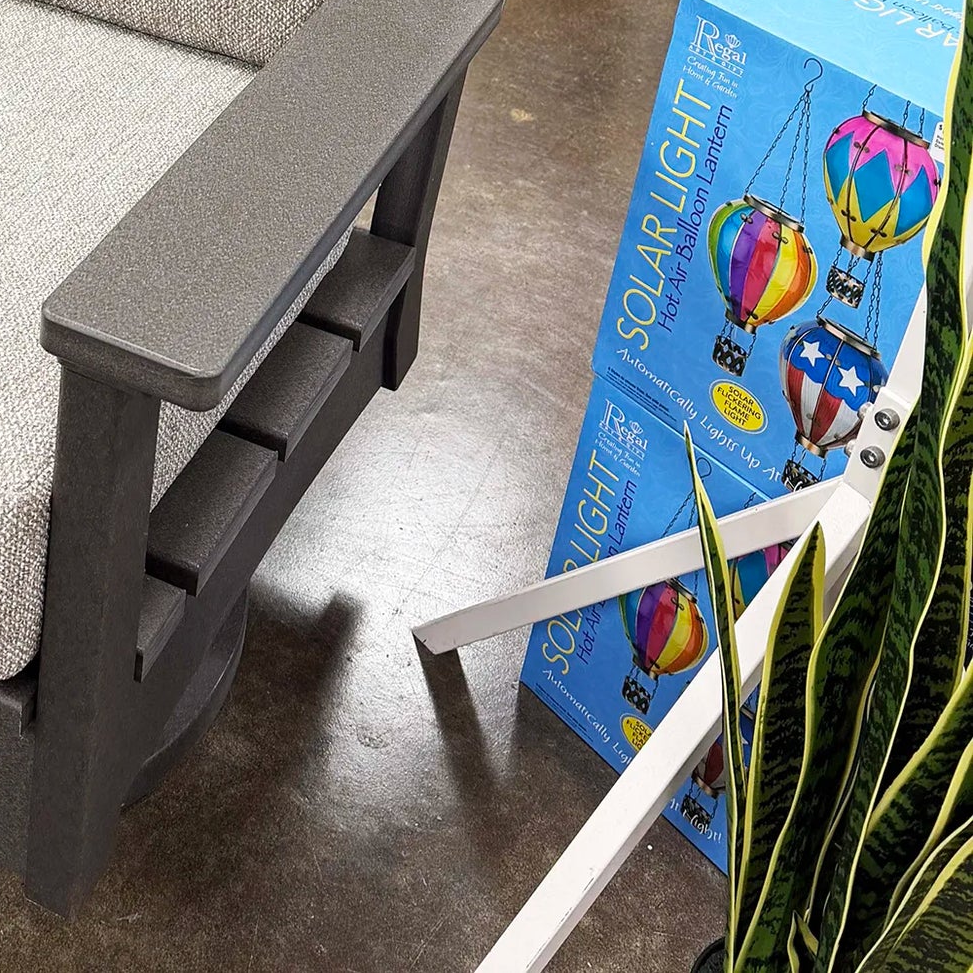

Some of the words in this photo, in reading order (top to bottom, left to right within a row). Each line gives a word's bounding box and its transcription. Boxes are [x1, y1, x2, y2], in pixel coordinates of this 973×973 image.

[690, 15, 747, 65] Regal
[683, 65, 703, 81] Home
[712, 81, 737, 99] Garden
[687, 56, 716, 80] Creating
[718, 71, 730, 84] Fun
[696, 104, 733, 185] Lantern
[616, 214, 677, 351] SOLAR
[649, 78, 711, 213] LIGHT
[675, 187, 708, 263] Balloon
[667, 261, 689, 295] Air
[658, 292, 680, 333] Hot
[717, 387, 761, 420] FLICKERING
[723, 408, 747, 426] LIGHT
[724, 399, 749, 421] FLAME
[728, 386, 754, 407] SOLAR
[599, 398, 648, 451] Regal
[700, 415, 739, 452] Lights
[740, 446, 761, 469] Up
[762, 466, 781, 482] At
[570, 449, 620, 562] LIGHT
[577, 630, 595, 665] Hot
[586, 607, 602, 635] Air
[612, 480, 637, 547] Lantern
